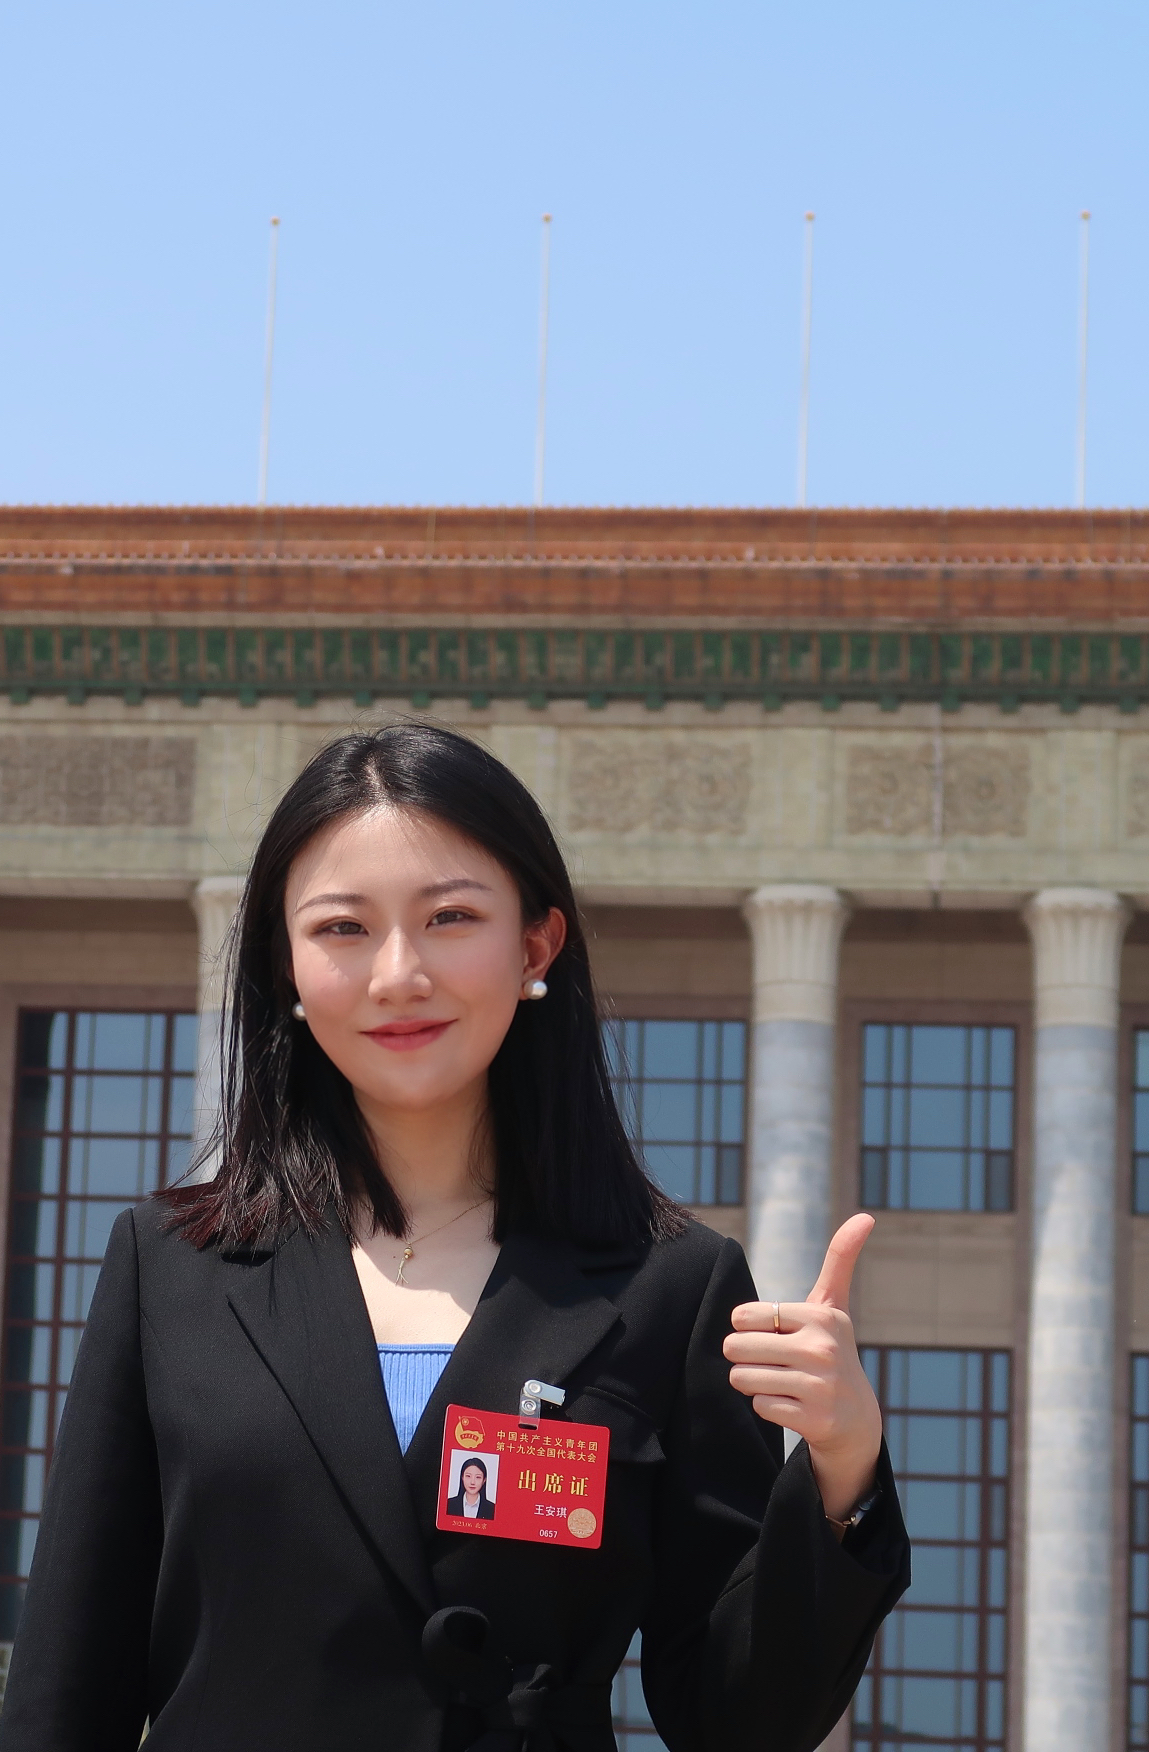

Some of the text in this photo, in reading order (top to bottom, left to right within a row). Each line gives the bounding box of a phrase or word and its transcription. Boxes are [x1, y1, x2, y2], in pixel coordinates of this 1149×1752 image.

[497, 1430, 598, 1451] 中国共产主义青年团
[496, 1441, 597, 1463] 第十九次全国代表大会
[518, 1469, 589, 1496] 出席证
[534, 1504, 567, 1518] 王安琪
[539, 1529, 558, 1539] 0657
